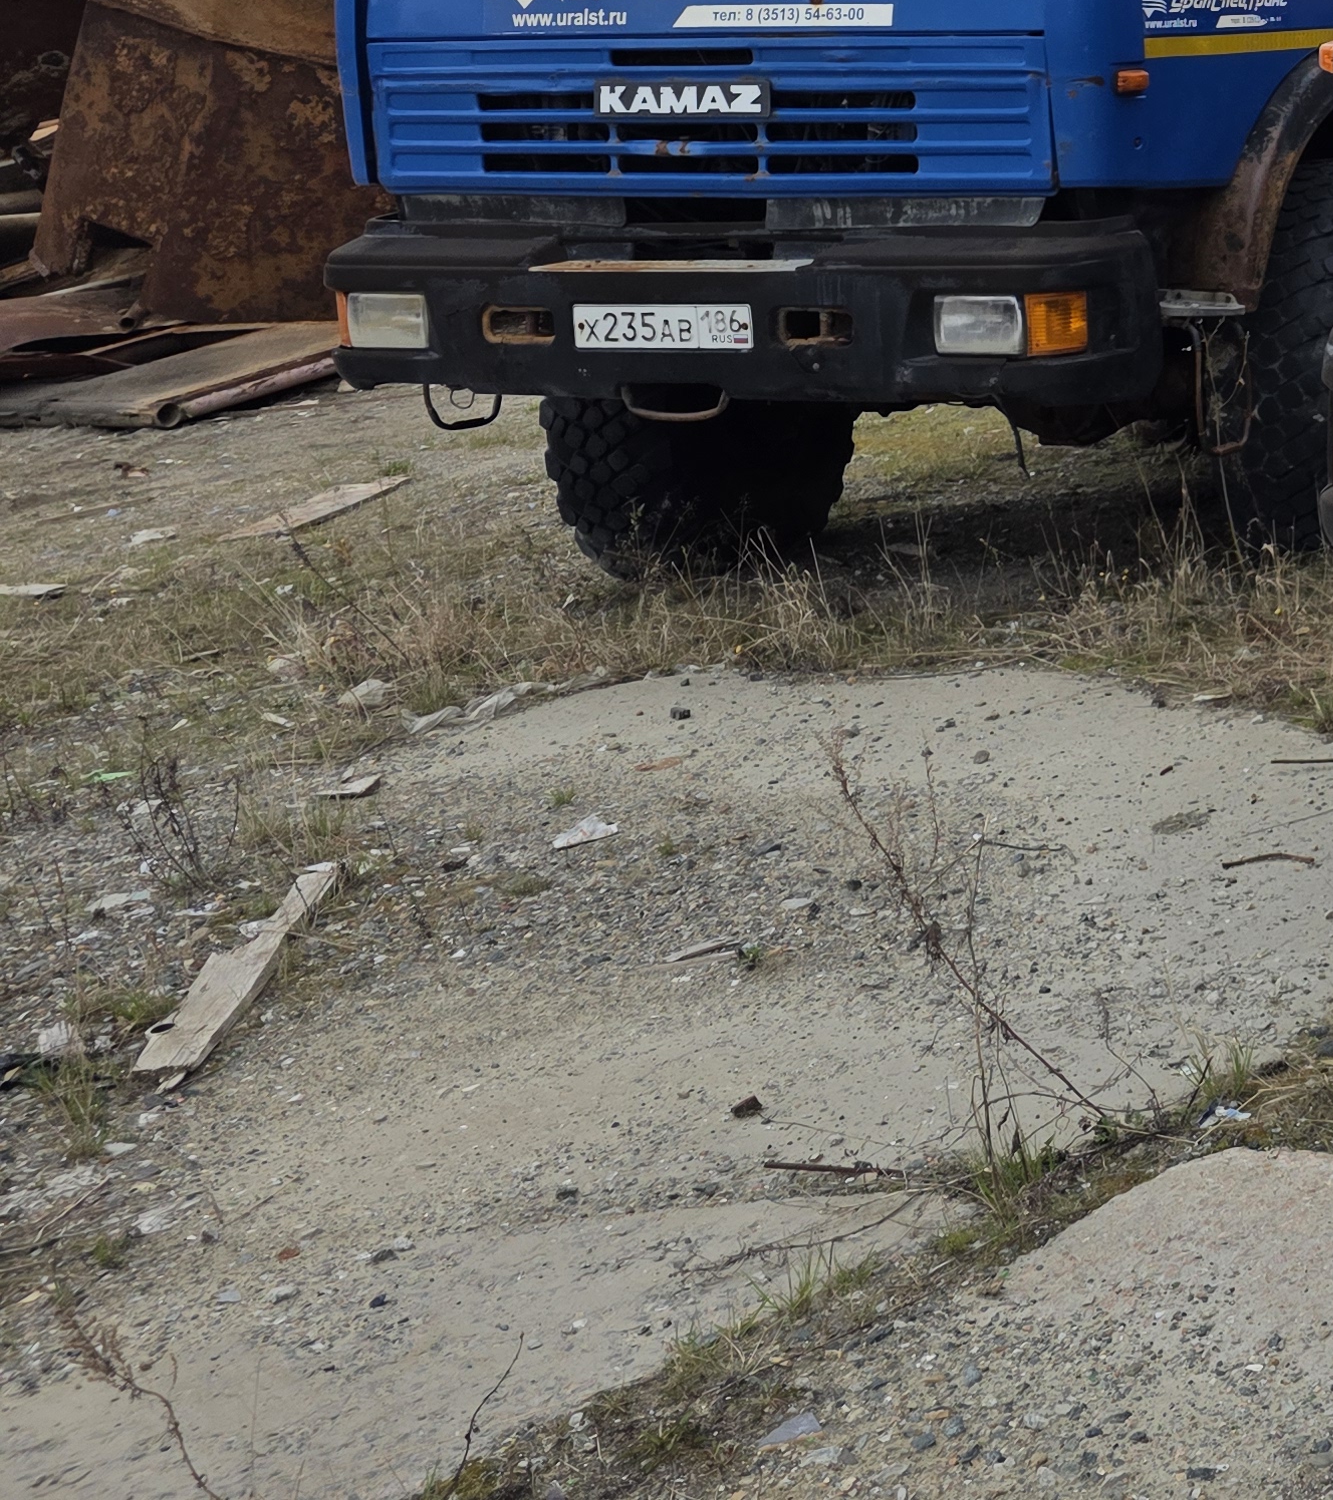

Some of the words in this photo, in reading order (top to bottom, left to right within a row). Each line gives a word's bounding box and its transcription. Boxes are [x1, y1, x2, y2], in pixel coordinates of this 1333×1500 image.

[512, 8, 627, 27] www.uralst.ru
[712, 8, 741, 22] тел:
[745, 7, 754, 21] 8
[757, 7, 801, 25] (3513)
[804, 6, 865, 22] 54-63-00
[600, 84, 762, 113] KAMAZ
[700, 310, 741, 333] 186
[712, 334, 733, 343] RUS
